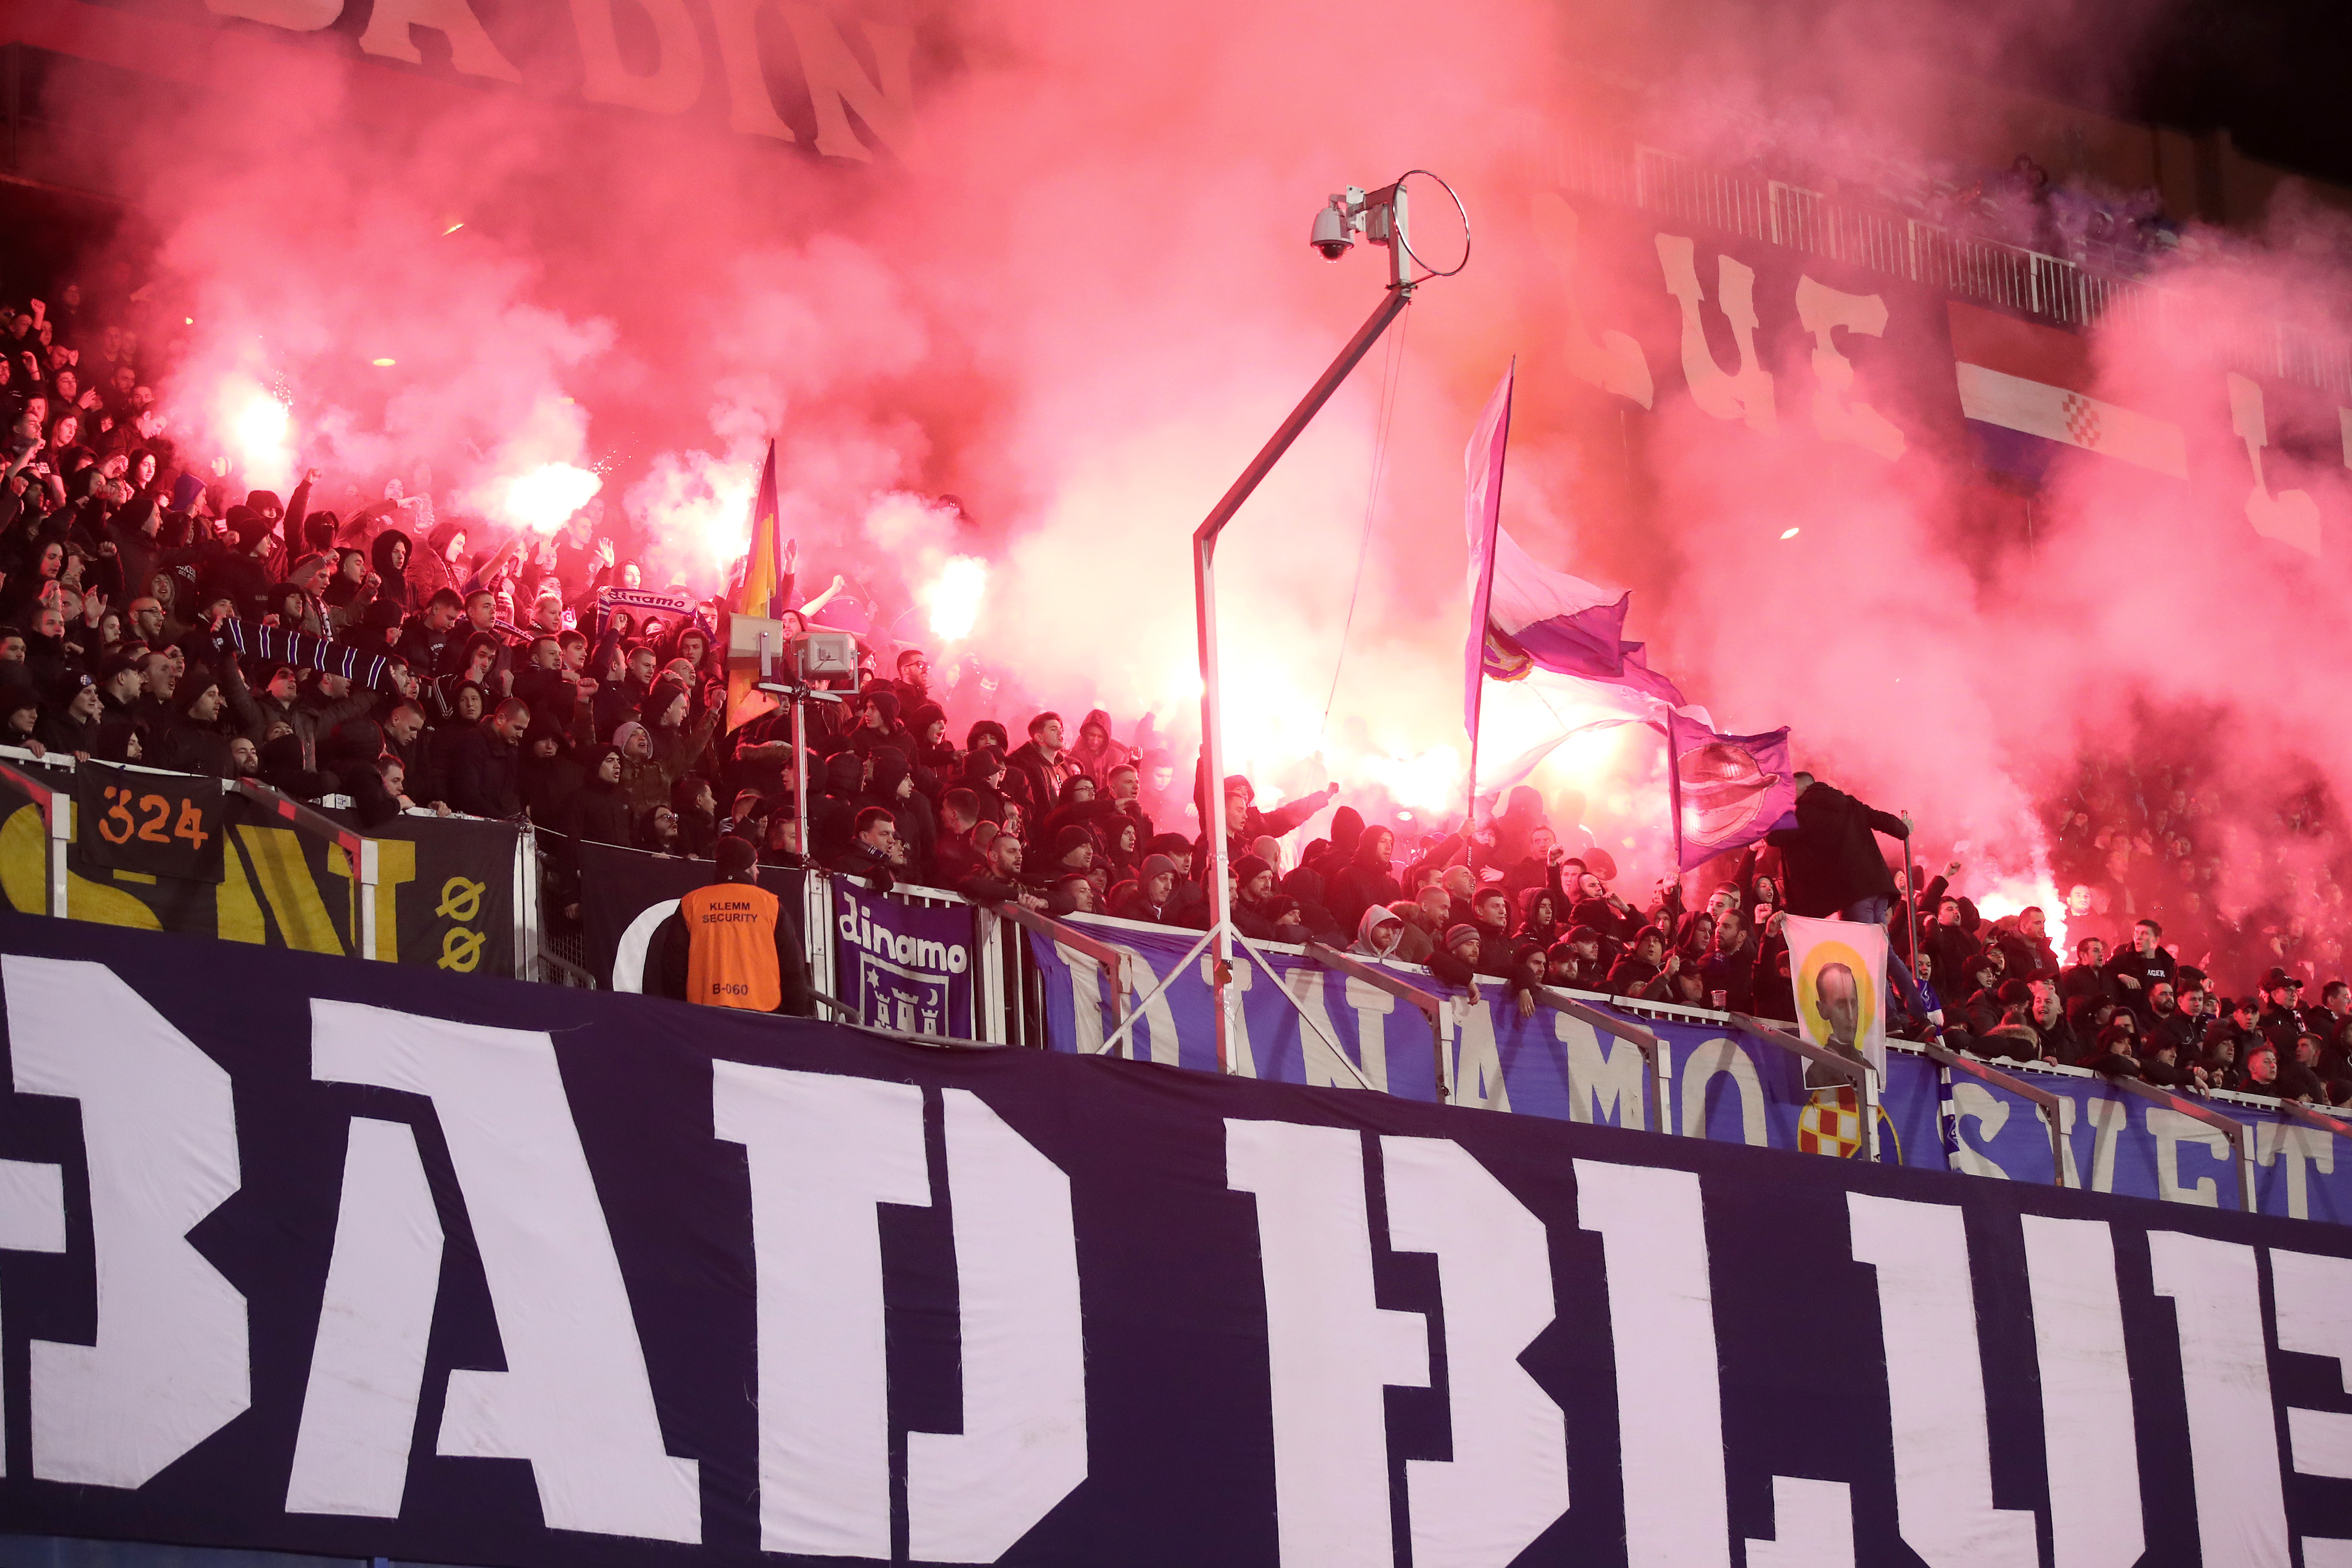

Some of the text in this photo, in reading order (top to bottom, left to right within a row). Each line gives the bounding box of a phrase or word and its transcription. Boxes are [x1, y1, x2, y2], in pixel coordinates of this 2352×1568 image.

[99, 785, 209, 850] 324
[702, 914, 759, 924] SECURITY
[710, 902, 751, 911] KLEMM
[839, 891, 967, 974] dinamo
[712, 983, 749, 995] B-060
[1053, 940, 1768, 1147] DINAMO
[0, 952, 2352, 1568] BAD BLUE
